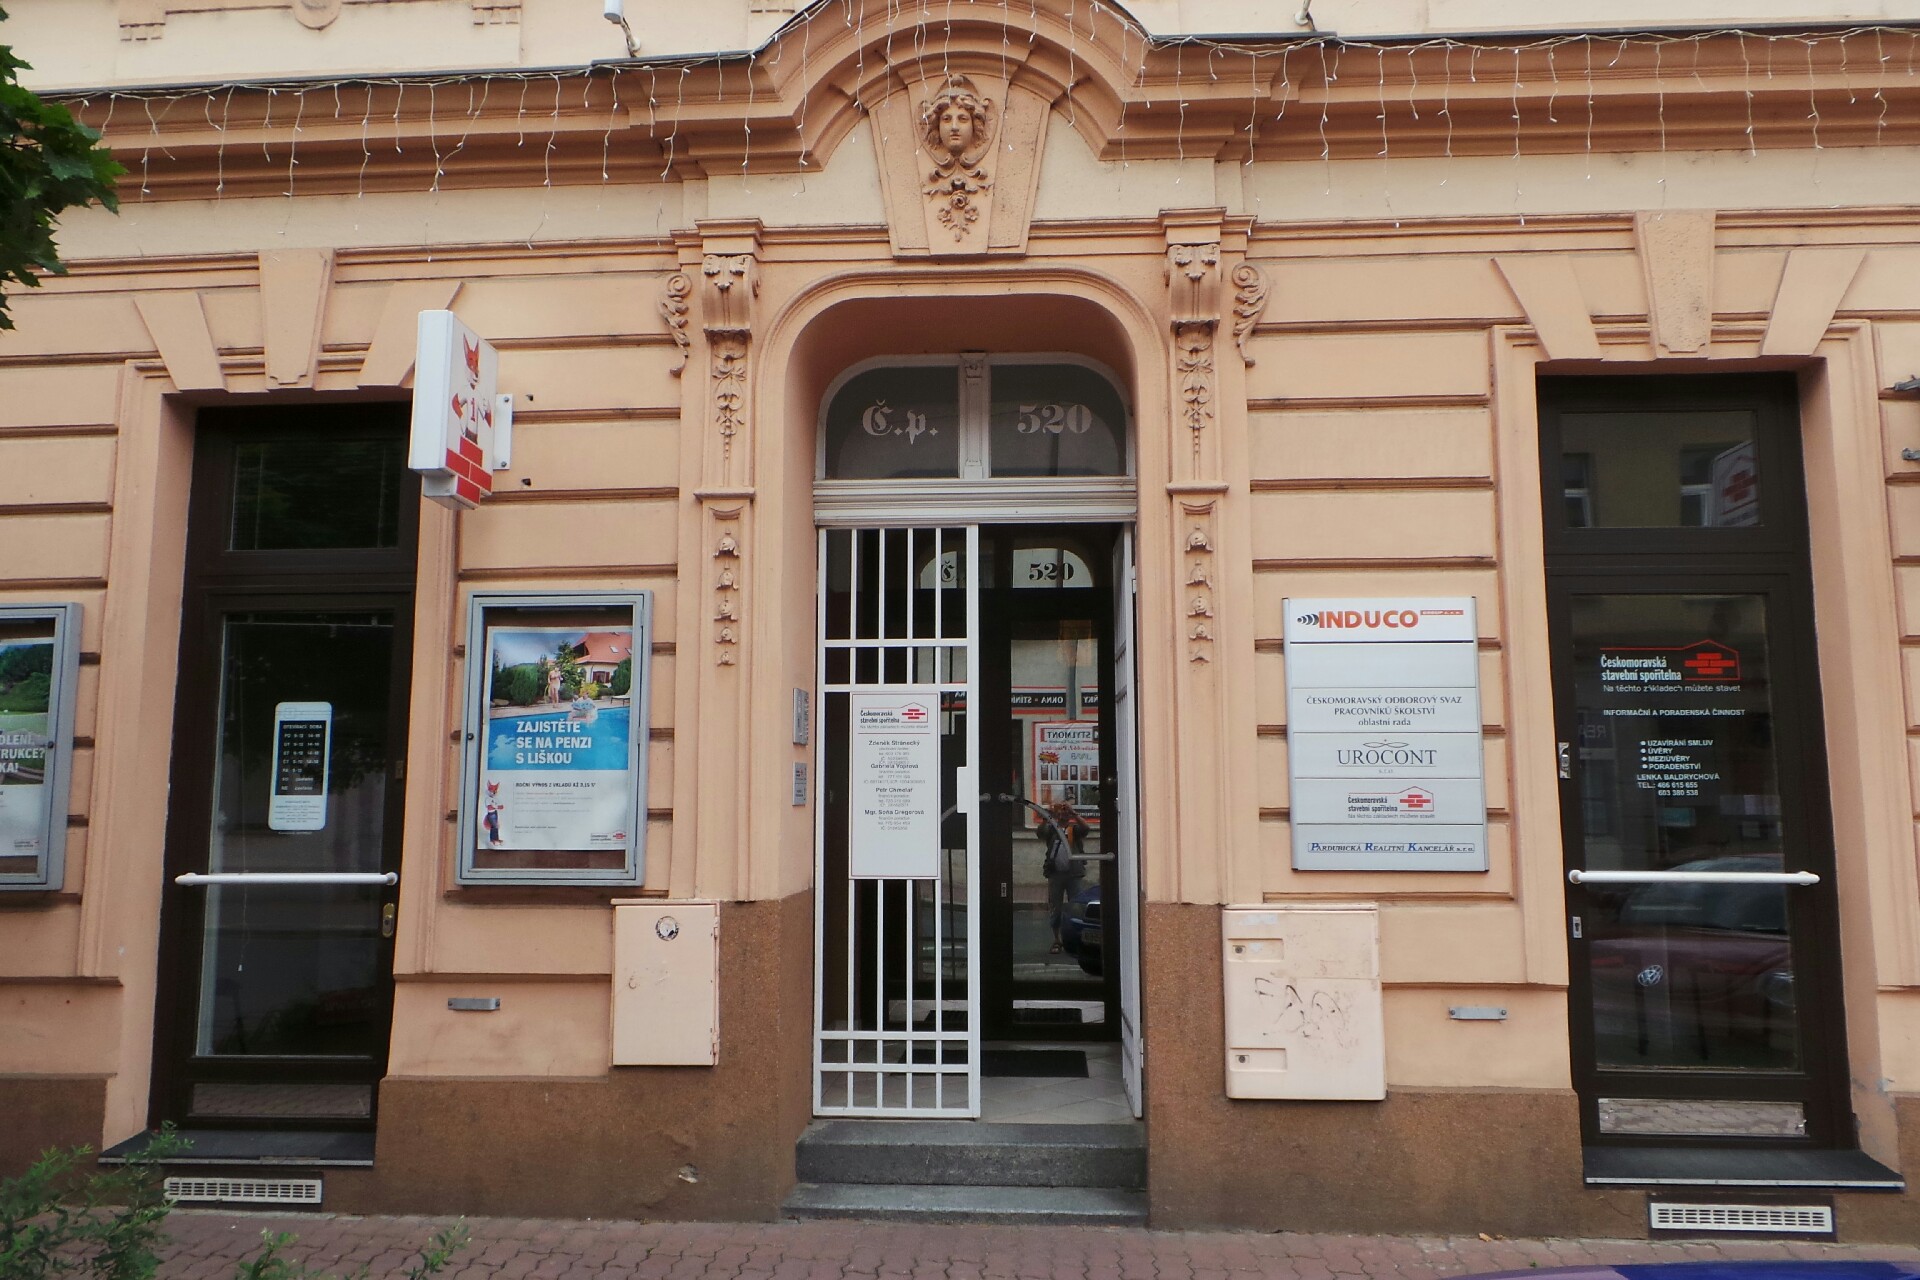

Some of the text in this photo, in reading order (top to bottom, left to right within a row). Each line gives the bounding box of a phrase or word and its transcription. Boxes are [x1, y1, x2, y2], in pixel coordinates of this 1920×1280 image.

[1017, 404, 1092, 434] 520
[1029, 562, 1075, 581] 520
[1318, 610, 1419, 629] INDUCO
[1600, 654, 1667, 668] Českomoravská
[1602, 669, 1682, 682] stavební spořitelna
[1603, 684, 1614, 692] Na
[1616, 684, 1642, 692] těchto
[1684, 684, 1714, 692] můžete
[1306, 695, 1462, 704] ČESKOMORAVSKÝ ODBOROVÝ SVAZ
[1334, 706, 1435, 715] PRACOVNÍKŮ ŠKOLSTVÍ
[1604, 708, 1650, 716] INFORMAČNÍ
[1660, 708, 1710, 716] PORADENSKÁ
[1712, 708, 1746, 716] ČINNOST
[516, 718, 581, 733] ZAJISTĚTE
[1358, 718, 1411, 726] oblastní rada
[516, 737, 592, 749] SE NA PENZI
[516, 750, 572, 764] S LIŠKOU
[1337, 750, 1438, 765] UROCONT
[1348, 795, 1388, 804] Českomoravská
[1372, 805, 1398, 813] spořitelna
